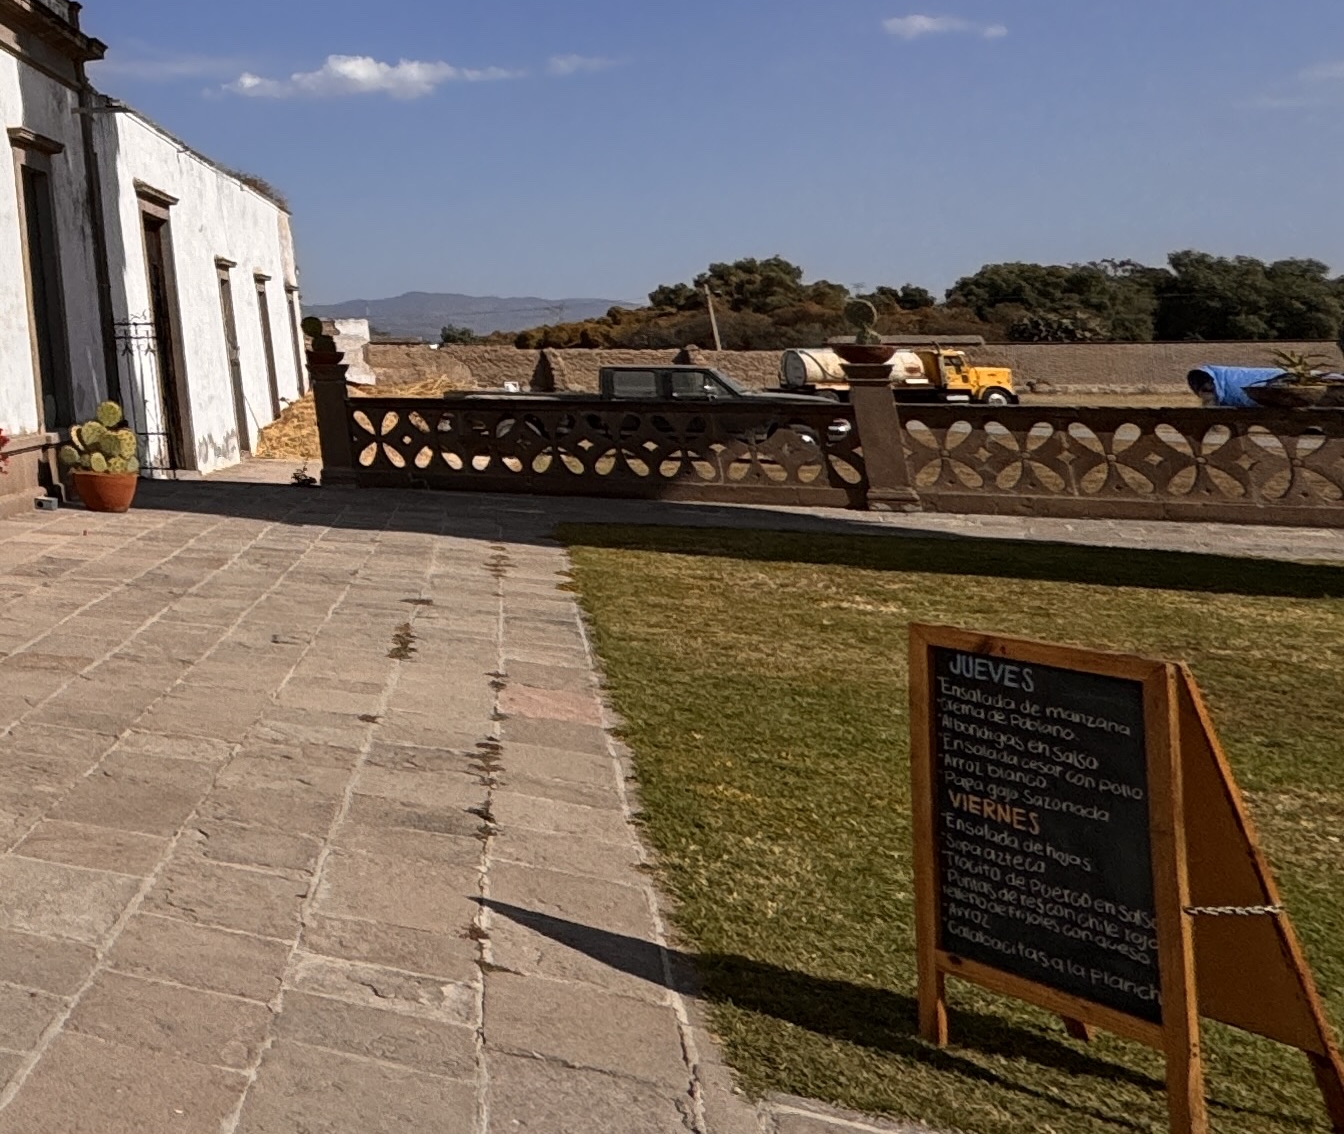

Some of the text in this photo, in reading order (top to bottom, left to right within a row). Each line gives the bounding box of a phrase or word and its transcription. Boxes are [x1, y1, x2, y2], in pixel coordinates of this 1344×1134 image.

[949, 653, 1034, 693] JUEVES
[986, 709, 1008, 725] de
[1020, 700, 1041, 716] de
[1046, 707, 1130, 737] manzana
[1027, 740, 1051, 757] en
[987, 763, 1047, 789] blanco
[1021, 758, 1063, 777] cesar
[1065, 770, 1096, 789] con
[948, 788, 1040, 836] VIERNES
[983, 847, 1046, 874] azteca
[1023, 840, 1045, 857] de
[1045, 842, 1092, 873] hojas
[997, 888, 1018, 905] de
[1019, 894, 1045, 915] res
[1045, 903, 1075, 922] con
[1005, 872, 1027, 890] de
[1094, 898, 1117, 916] en
[949, 902, 992, 929] Arroz
[987, 902, 1008, 917] de
[1062, 924, 1093, 942] con
[1094, 935, 1151, 964] queso
[1051, 957, 1064, 973] a
[1067, 959, 1087, 979] la
